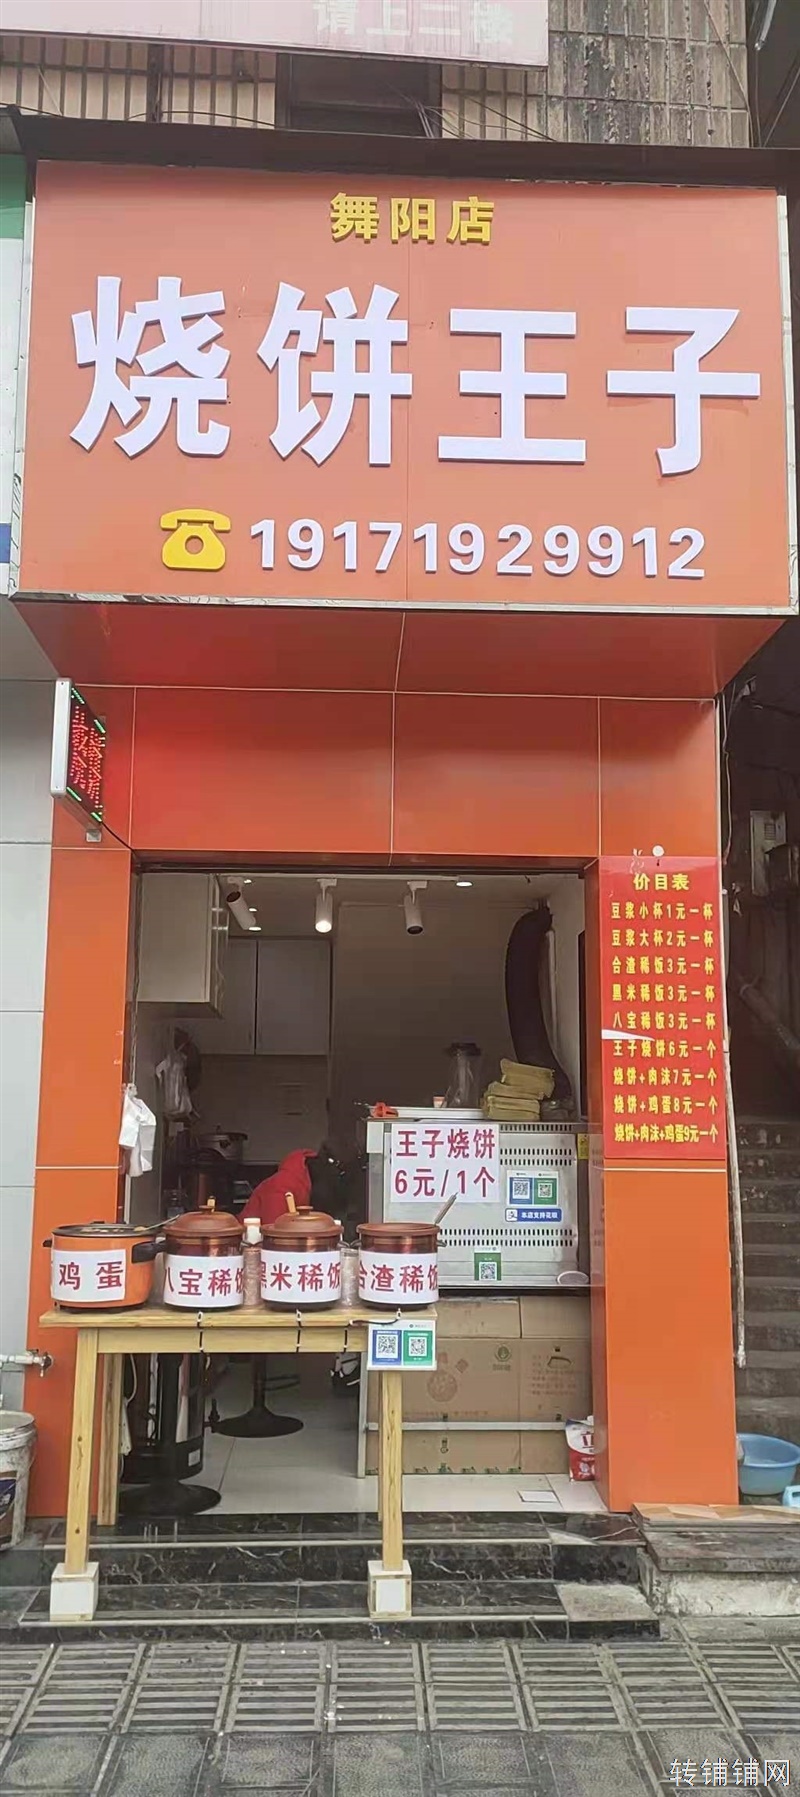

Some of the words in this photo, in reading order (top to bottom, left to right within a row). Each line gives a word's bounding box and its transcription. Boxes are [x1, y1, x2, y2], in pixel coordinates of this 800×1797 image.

[330, 192, 494, 244] 舞阳店
[69, 276, 761, 476] 烧饼王子
[249, 518, 706, 578] 19171929912
[633, 873, 690, 891] 价目表
[611, 901, 713, 920] 豆浆小杯1元一杯
[611, 929, 714, 948] 豆浆大杯2元一杯
[612, 955, 715, 975] 合渣稀饭3元一杯
[612, 983, 715, 1002] 黑米稀饭3元一杯
[612, 1011, 716, 1030] 八宝稀饭3元一杯
[613, 1040, 716, 1059] 王子烧饼6元一个
[613, 1095, 718, 1115] 烧饼+鸡蛋8元一个
[396, 1128, 495, 1159] 王子烧饼
[394, 1166, 495, 1197] 6元/1个
[58, 1260, 123, 1291] 鸡蛋
